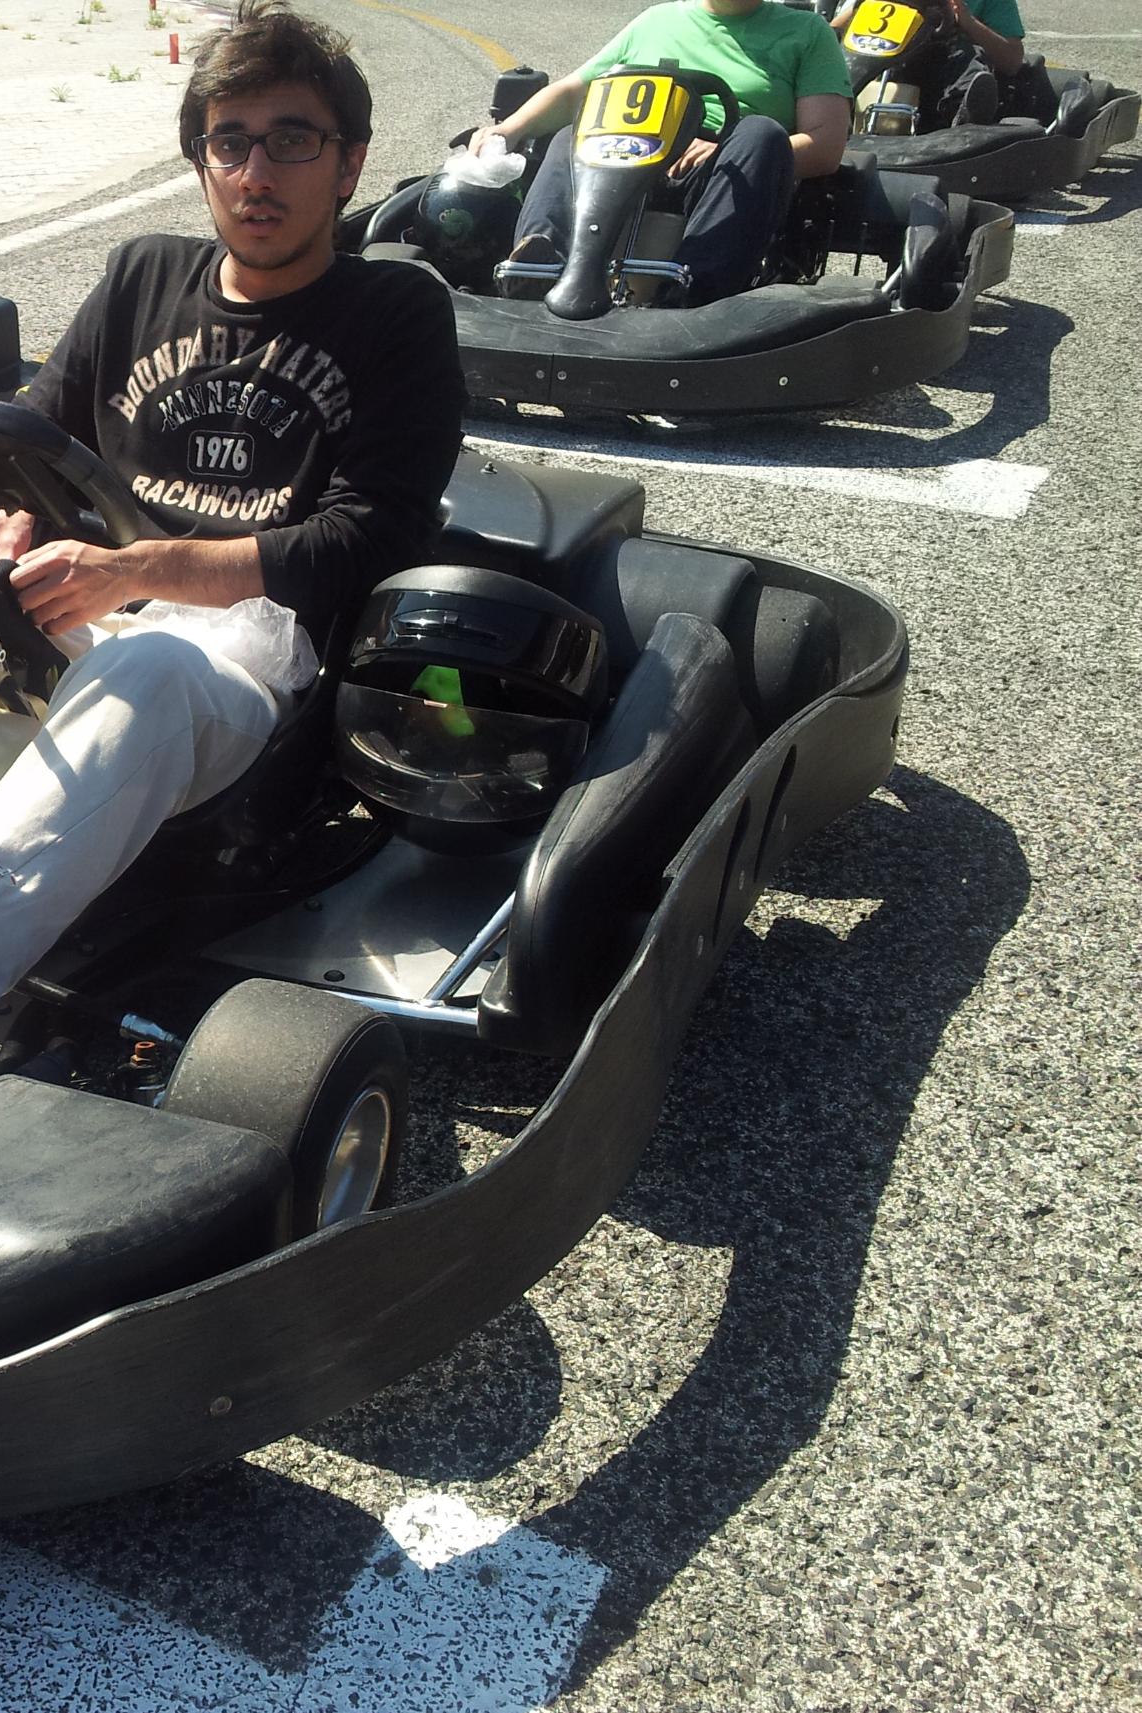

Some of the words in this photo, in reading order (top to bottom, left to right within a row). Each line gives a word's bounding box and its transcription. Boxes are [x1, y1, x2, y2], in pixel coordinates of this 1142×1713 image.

[868, 4, 896, 34] 3
[589, 79, 656, 130] 19
[108, 324, 255, 425] BOUNDARY
[158, 381, 298, 438] MINNESOTA
[195, 436, 248, 471] 1976
[132, 475, 292, 523] BACKWOODS
